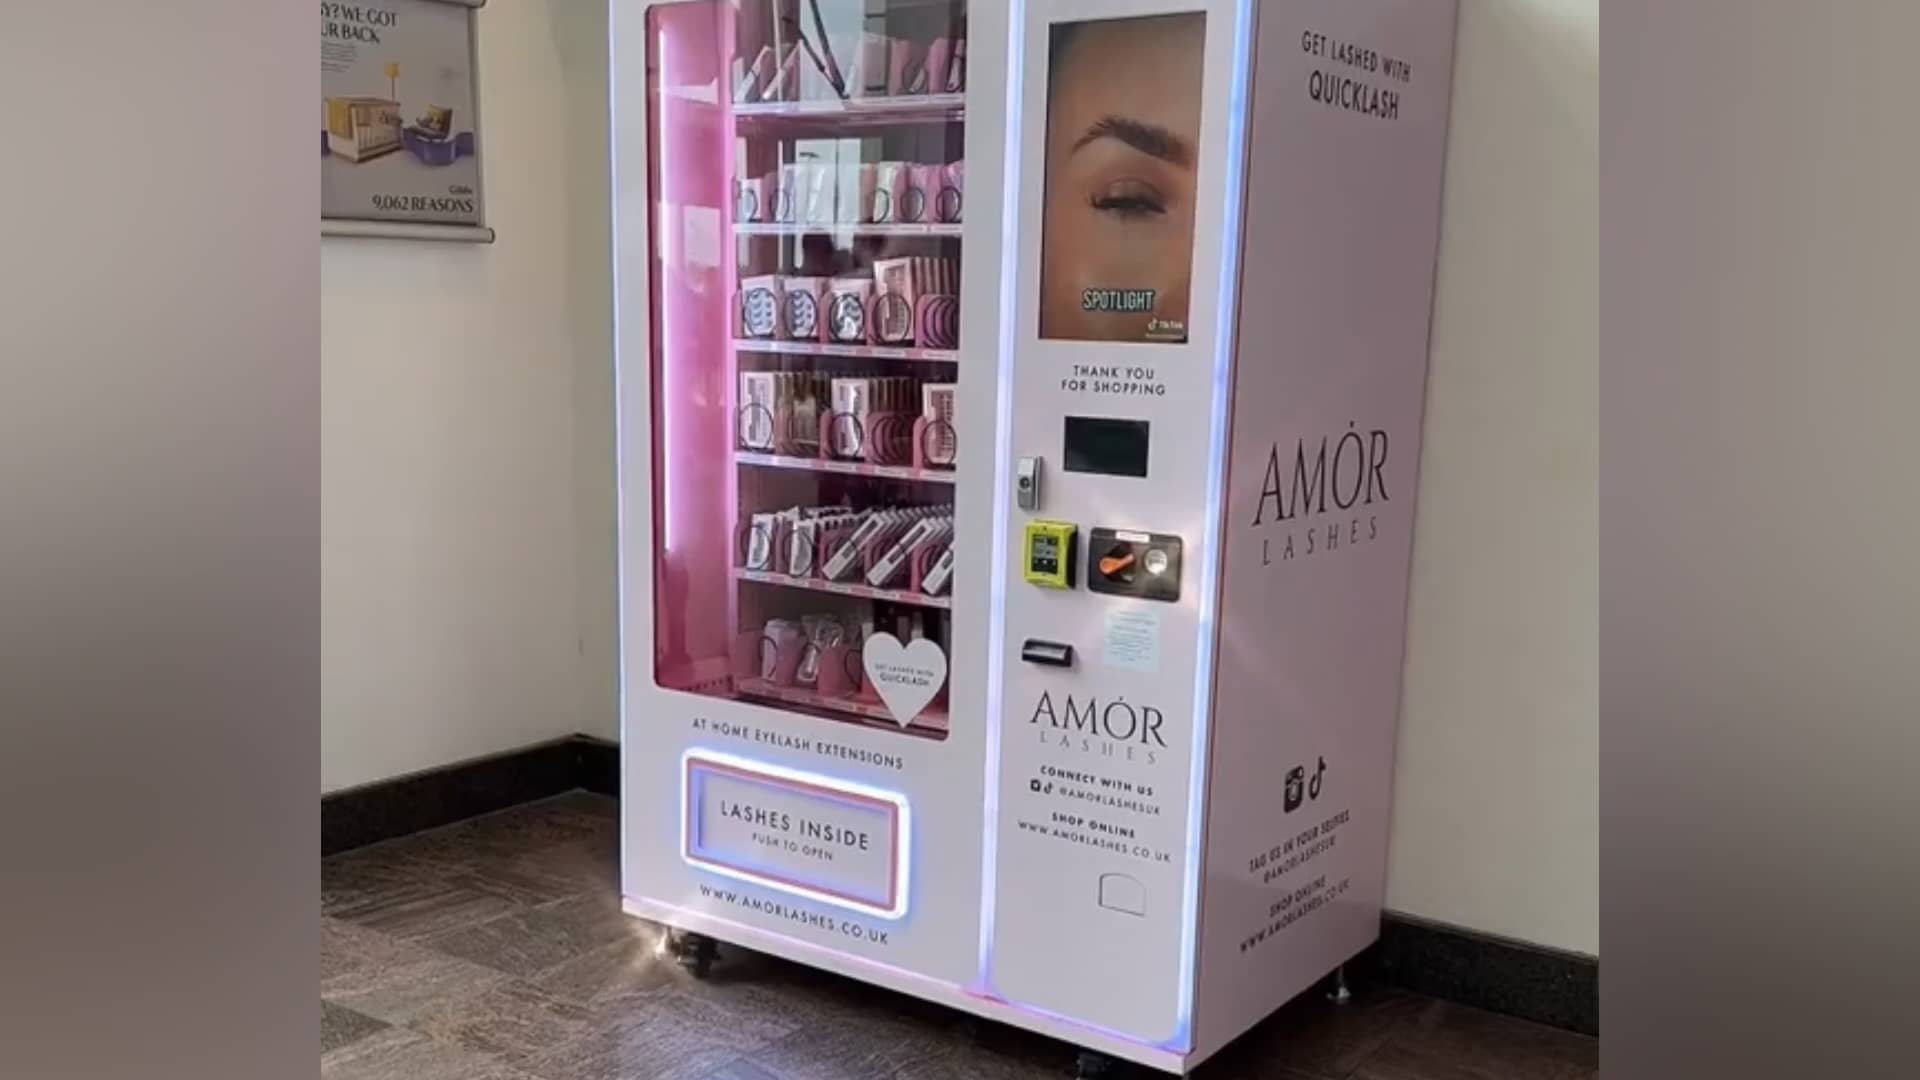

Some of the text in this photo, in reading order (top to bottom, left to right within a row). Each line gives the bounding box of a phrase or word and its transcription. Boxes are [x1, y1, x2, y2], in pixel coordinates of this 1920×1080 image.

[341, 5, 363, 21] WE
[366, 8, 397, 27] GOT
[341, 24, 381, 43] BACK
[1302, 30, 1411, 83] GET LASHED WITH
[1309, 70, 1399, 120] QUICKLASH
[371, 195, 474, 214] 9,062 REASONS
[1083, 290, 1154, 310] SPOTLIGHT
[1061, 379, 1166, 396] FOR SHOPPING
[1073, 365, 1155, 380] THANK YOU
[1263, 516, 1376, 566] LASHES
[692, 718, 904, 770] AT HOME EYELASH EXTENSIONS
[1039, 730, 1156, 765] LASHES
[1040, 765, 1154, 797] CONNECT WITH US
[720, 799, 869, 851] LASHES INSIDE
[1018, 820, 1171, 863] WWW.AMORLASHES.CO.UK
[1052, 811, 1136, 838] SHOP ONLINE
[1250, 809, 1350, 873] TAG US IN YOUR SELFIES
[753, 832, 833, 861] PUSH TO OPEN
[1270, 874, 1326, 918] SHOP ONLINE
[700, 884, 888, 945] WWW.AMORLASHES.CO.UK
